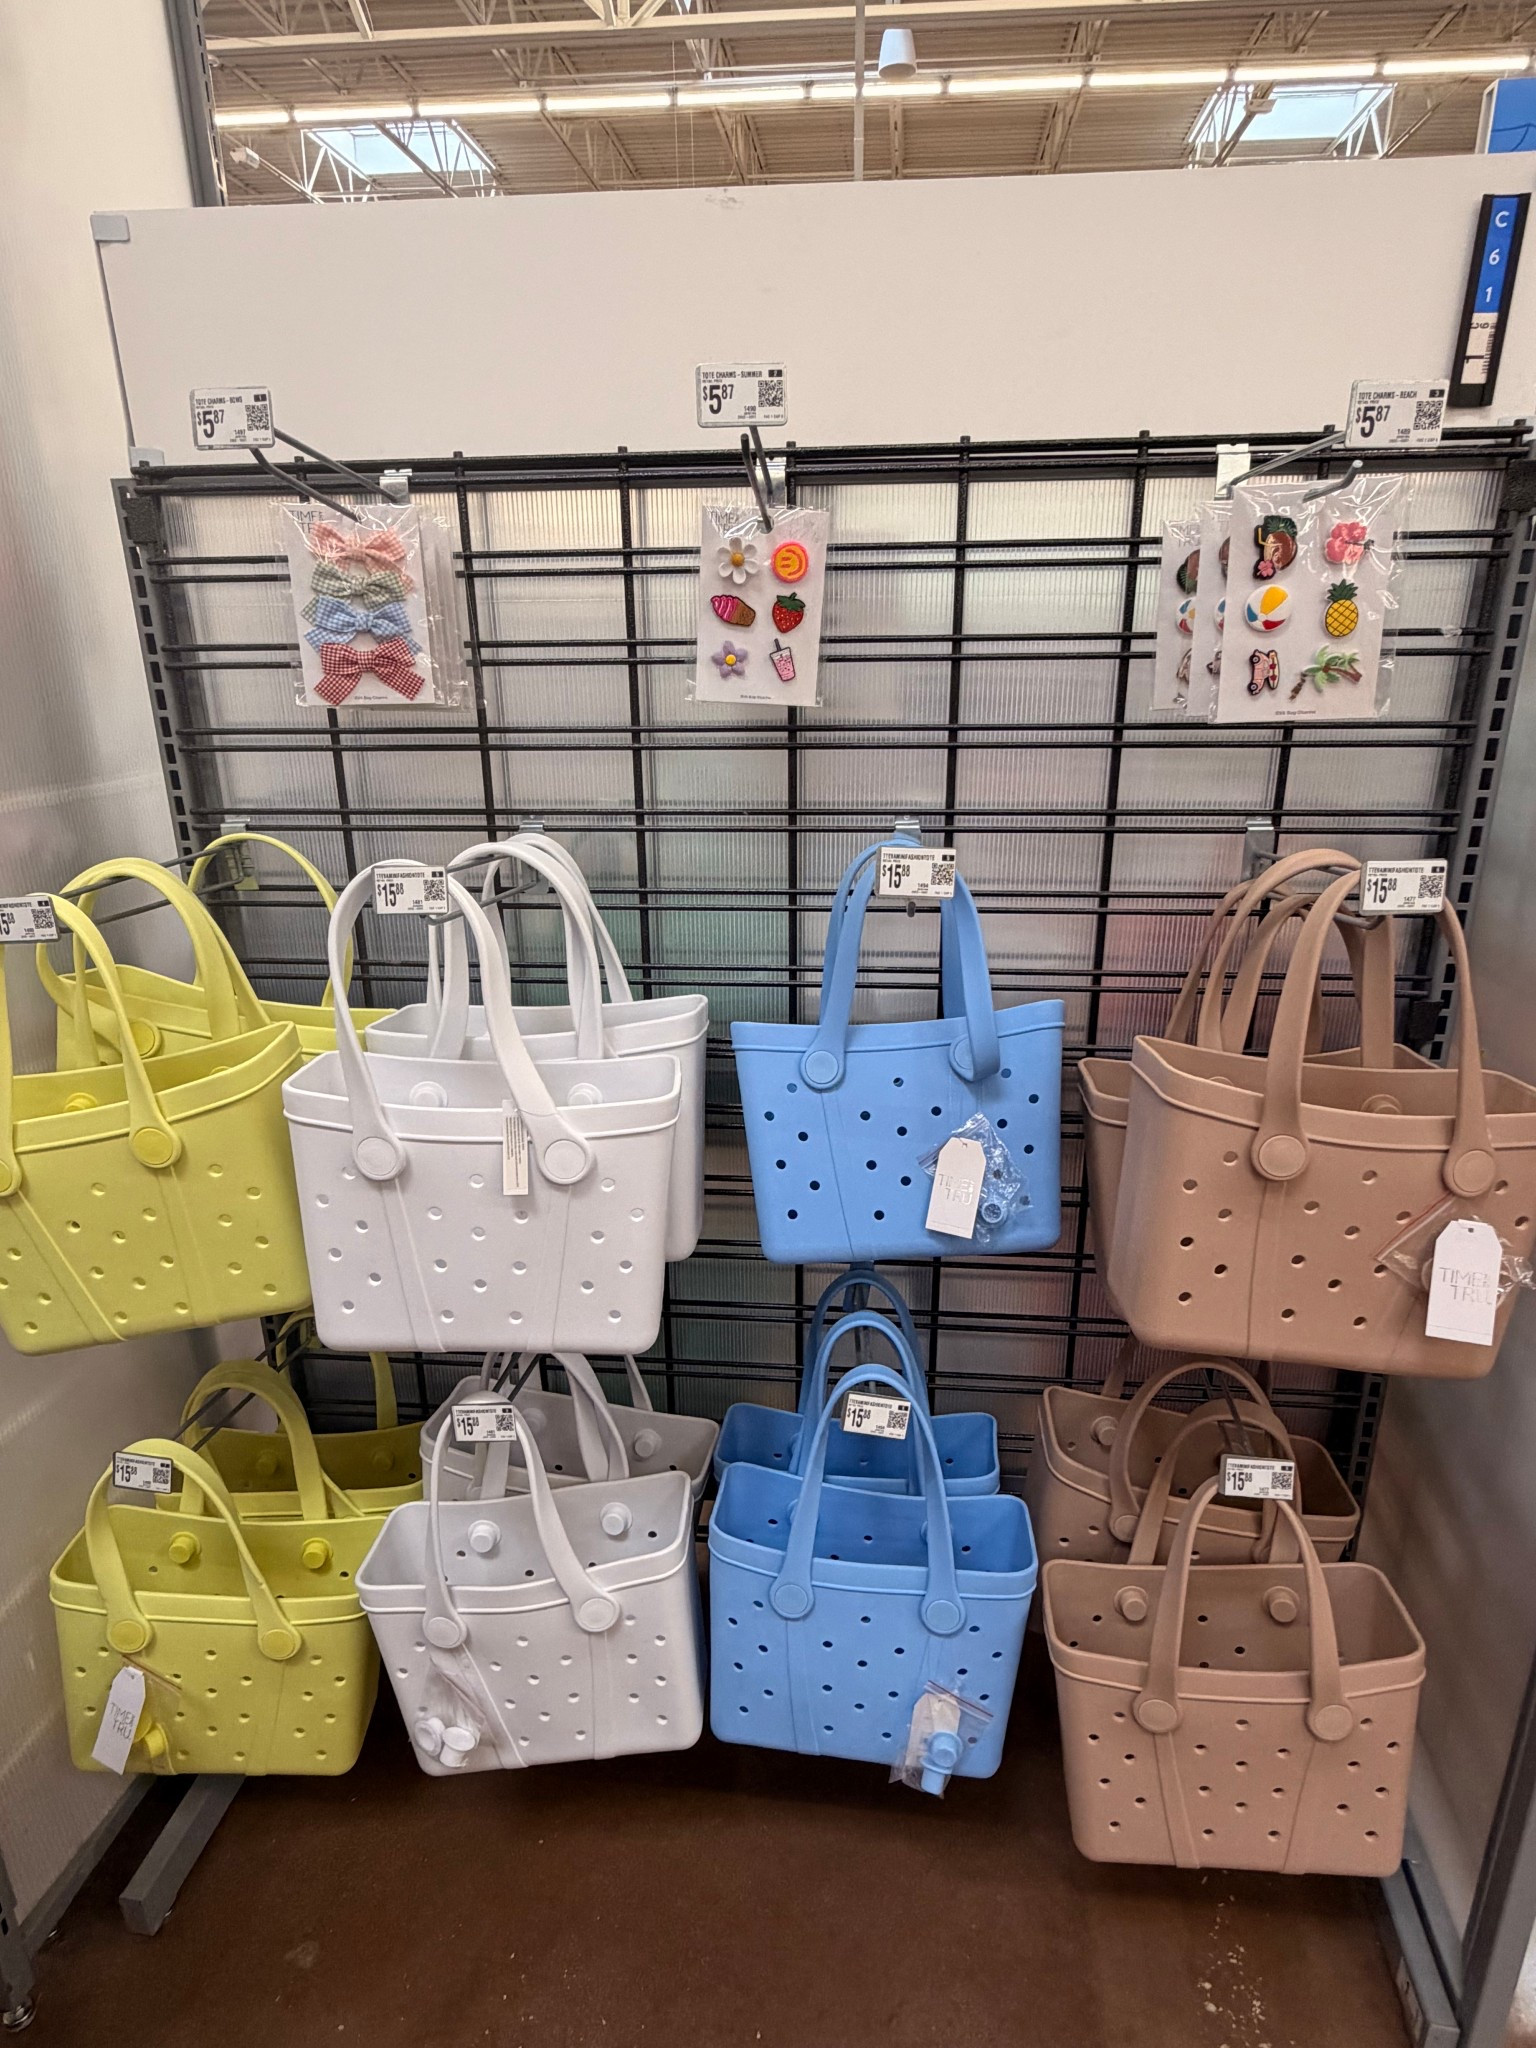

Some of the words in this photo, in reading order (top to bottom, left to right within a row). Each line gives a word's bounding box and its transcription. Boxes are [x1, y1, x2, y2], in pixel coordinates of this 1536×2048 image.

[702, 371, 715, 379] TOTE
[741, 370, 762, 378] SUMMER
[1359, 392, 1372, 400] TOTE
[1373, 391, 1395, 399] CHARMS
